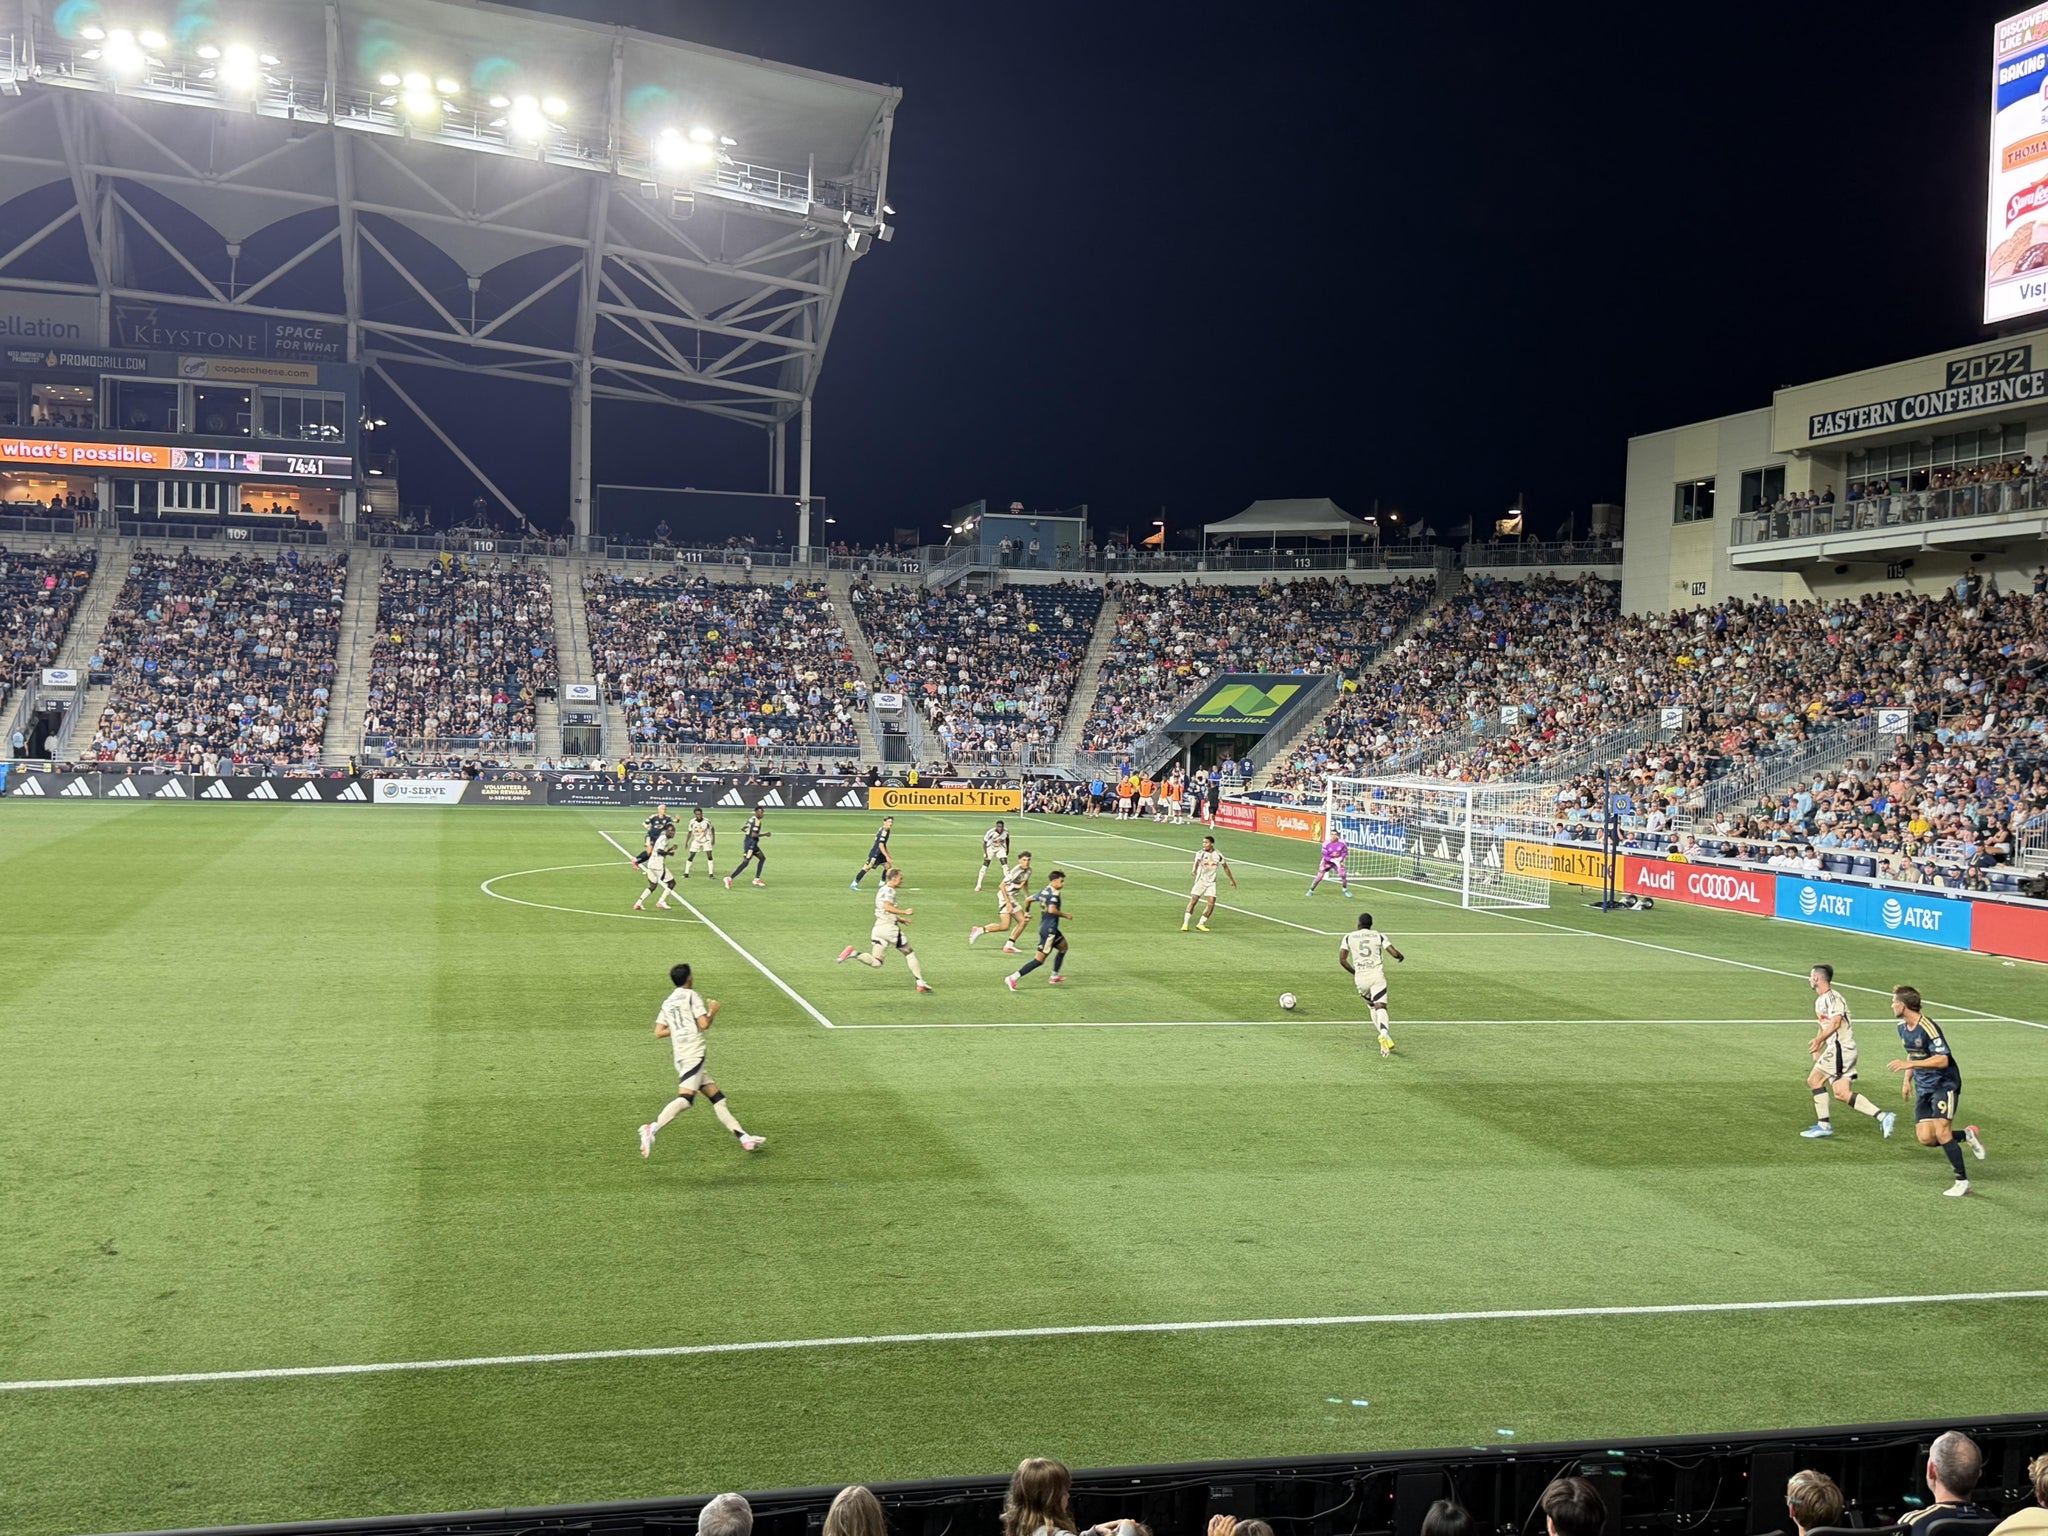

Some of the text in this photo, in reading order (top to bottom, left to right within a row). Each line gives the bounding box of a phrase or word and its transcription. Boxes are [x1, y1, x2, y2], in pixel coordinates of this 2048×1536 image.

[2000, 32, 2022, 53] LIKE
[2024, 30, 2032, 43] A
[2000, 53, 2046, 86] BAKING
[135, 324, 257, 350] KEYSTONE
[275, 325, 323, 340] SPACE
[275, 339, 340, 353] FOR WHAT
[60, 353, 146, 370] PROMOGRILL.COM
[1951, 349, 2024, 385] 2022
[214, 364, 309, 377] coopercheese.com
[1812, 371, 2045, 437] EASTERN CONFERENCE
[2, 442, 67, 459] what's
[194, 452, 204, 467] 3
[229, 454, 235, 469] 1
[287, 457, 323, 474] 74:41
[228, 529, 248, 540] 109
[474, 541, 493, 551] 110
[686, 552, 702, 562] 111
[1294, 558, 1311, 568] 113
[902, 563, 919, 573] 112
[1889, 564, 1904, 578] 115
[1693, 583, 1705, 595] 114
[400, 787, 446, 795] U-SERVE
[633, 784, 703, 793] SOFITEL
[883, 790, 1011, 807] Continental Tire
[1232, 806, 1256, 820] COMPANY
[1359, 823, 1406, 852] Medicine
[1514, 845, 1575, 874] Continental
[1637, 866, 1675, 890] Audi
[1818, 893, 1854, 917] AT&T
[1904, 907, 1943, 931] AT&T
[1359, 939, 1372, 957] 5
[1937, 1100, 1948, 1114] 9
